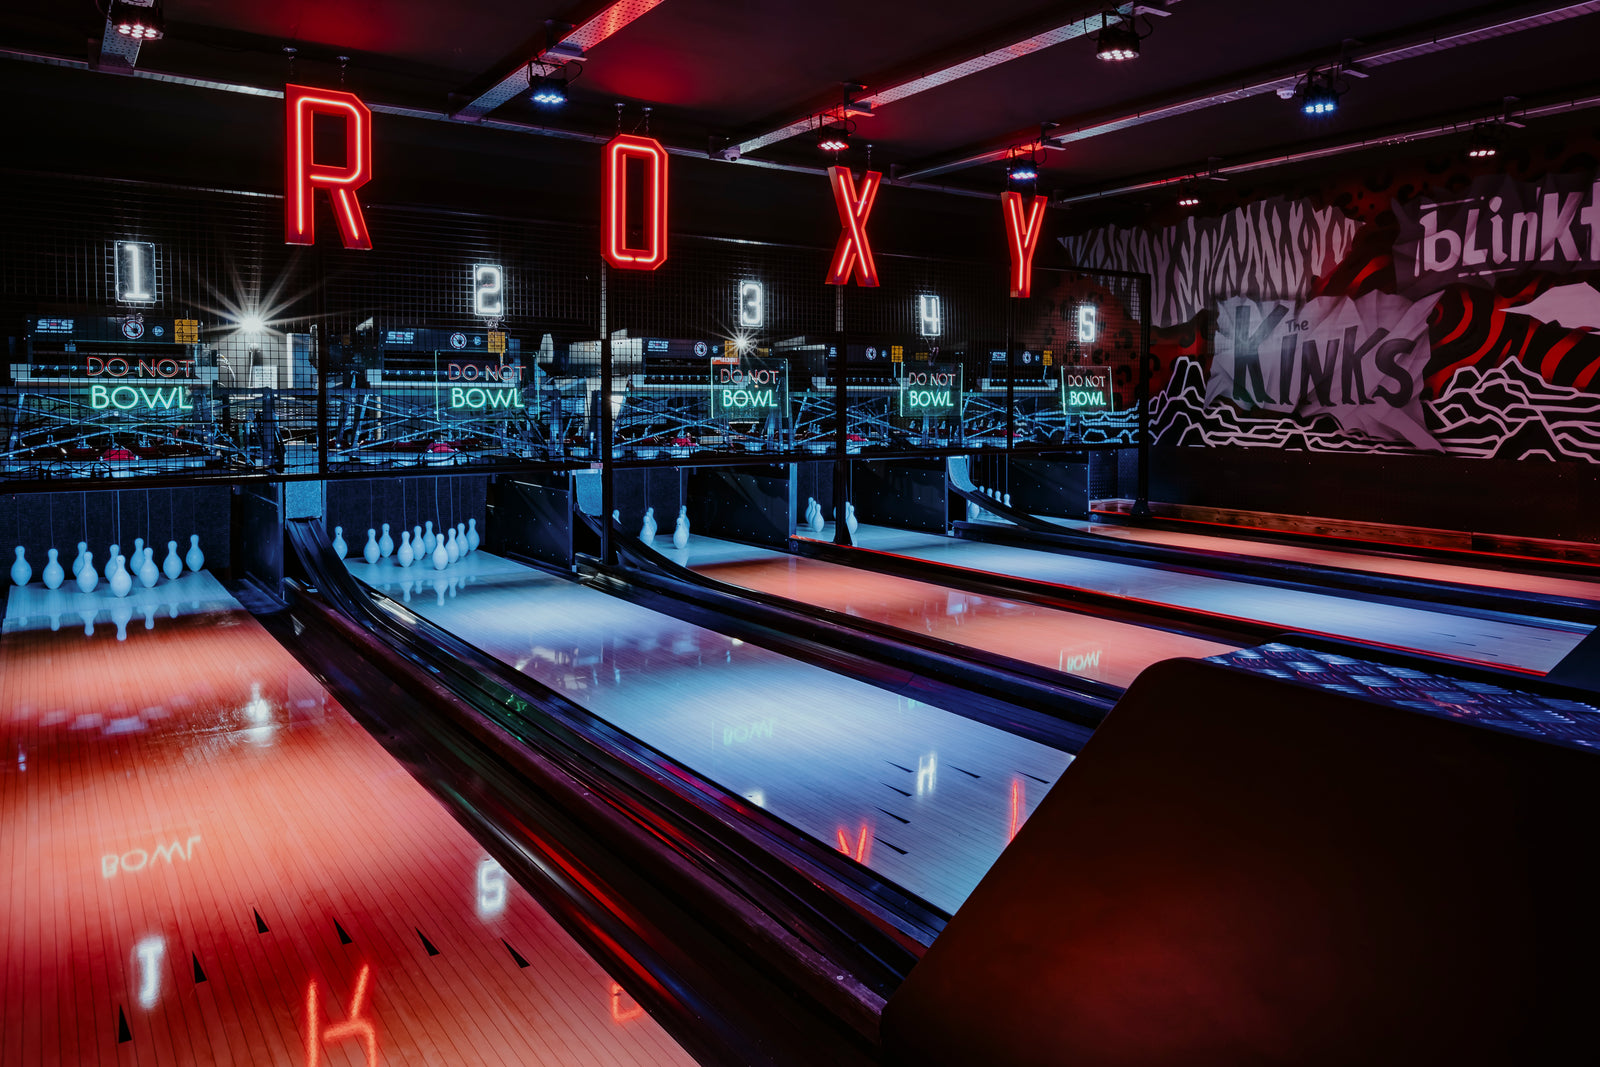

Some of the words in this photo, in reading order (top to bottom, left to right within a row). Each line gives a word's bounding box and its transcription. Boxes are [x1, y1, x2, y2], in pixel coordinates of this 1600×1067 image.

[285, 84, 1048, 298] ROXY
[124, 244, 151, 299] 1
[476, 266, 501, 314] 2
[742, 283, 762, 325] 3
[920, 295, 939, 334] 4
[1079, 306, 1095, 341] 5
[1285, 318, 1310, 333] The
[87, 356, 130, 377] DO
[139, 358, 195, 378] NOT
[448, 363, 479, 381] DO
[485, 364, 527, 381] NOT
[720, 368, 744, 383] DO
[747, 369, 779, 384] NOT
[908, 372, 928, 386] DO
[930, 373, 956, 386] NOT
[1067, 374, 1083, 387] DO
[1085, 375, 1106, 388] NOT
[91, 385, 193, 410] BOWL
[451, 387, 525, 409] BOWL
[722, 389, 778, 408] BOWL
[909, 390, 954, 407] BOWL
[1070, 391, 1106, 406] BOWL
